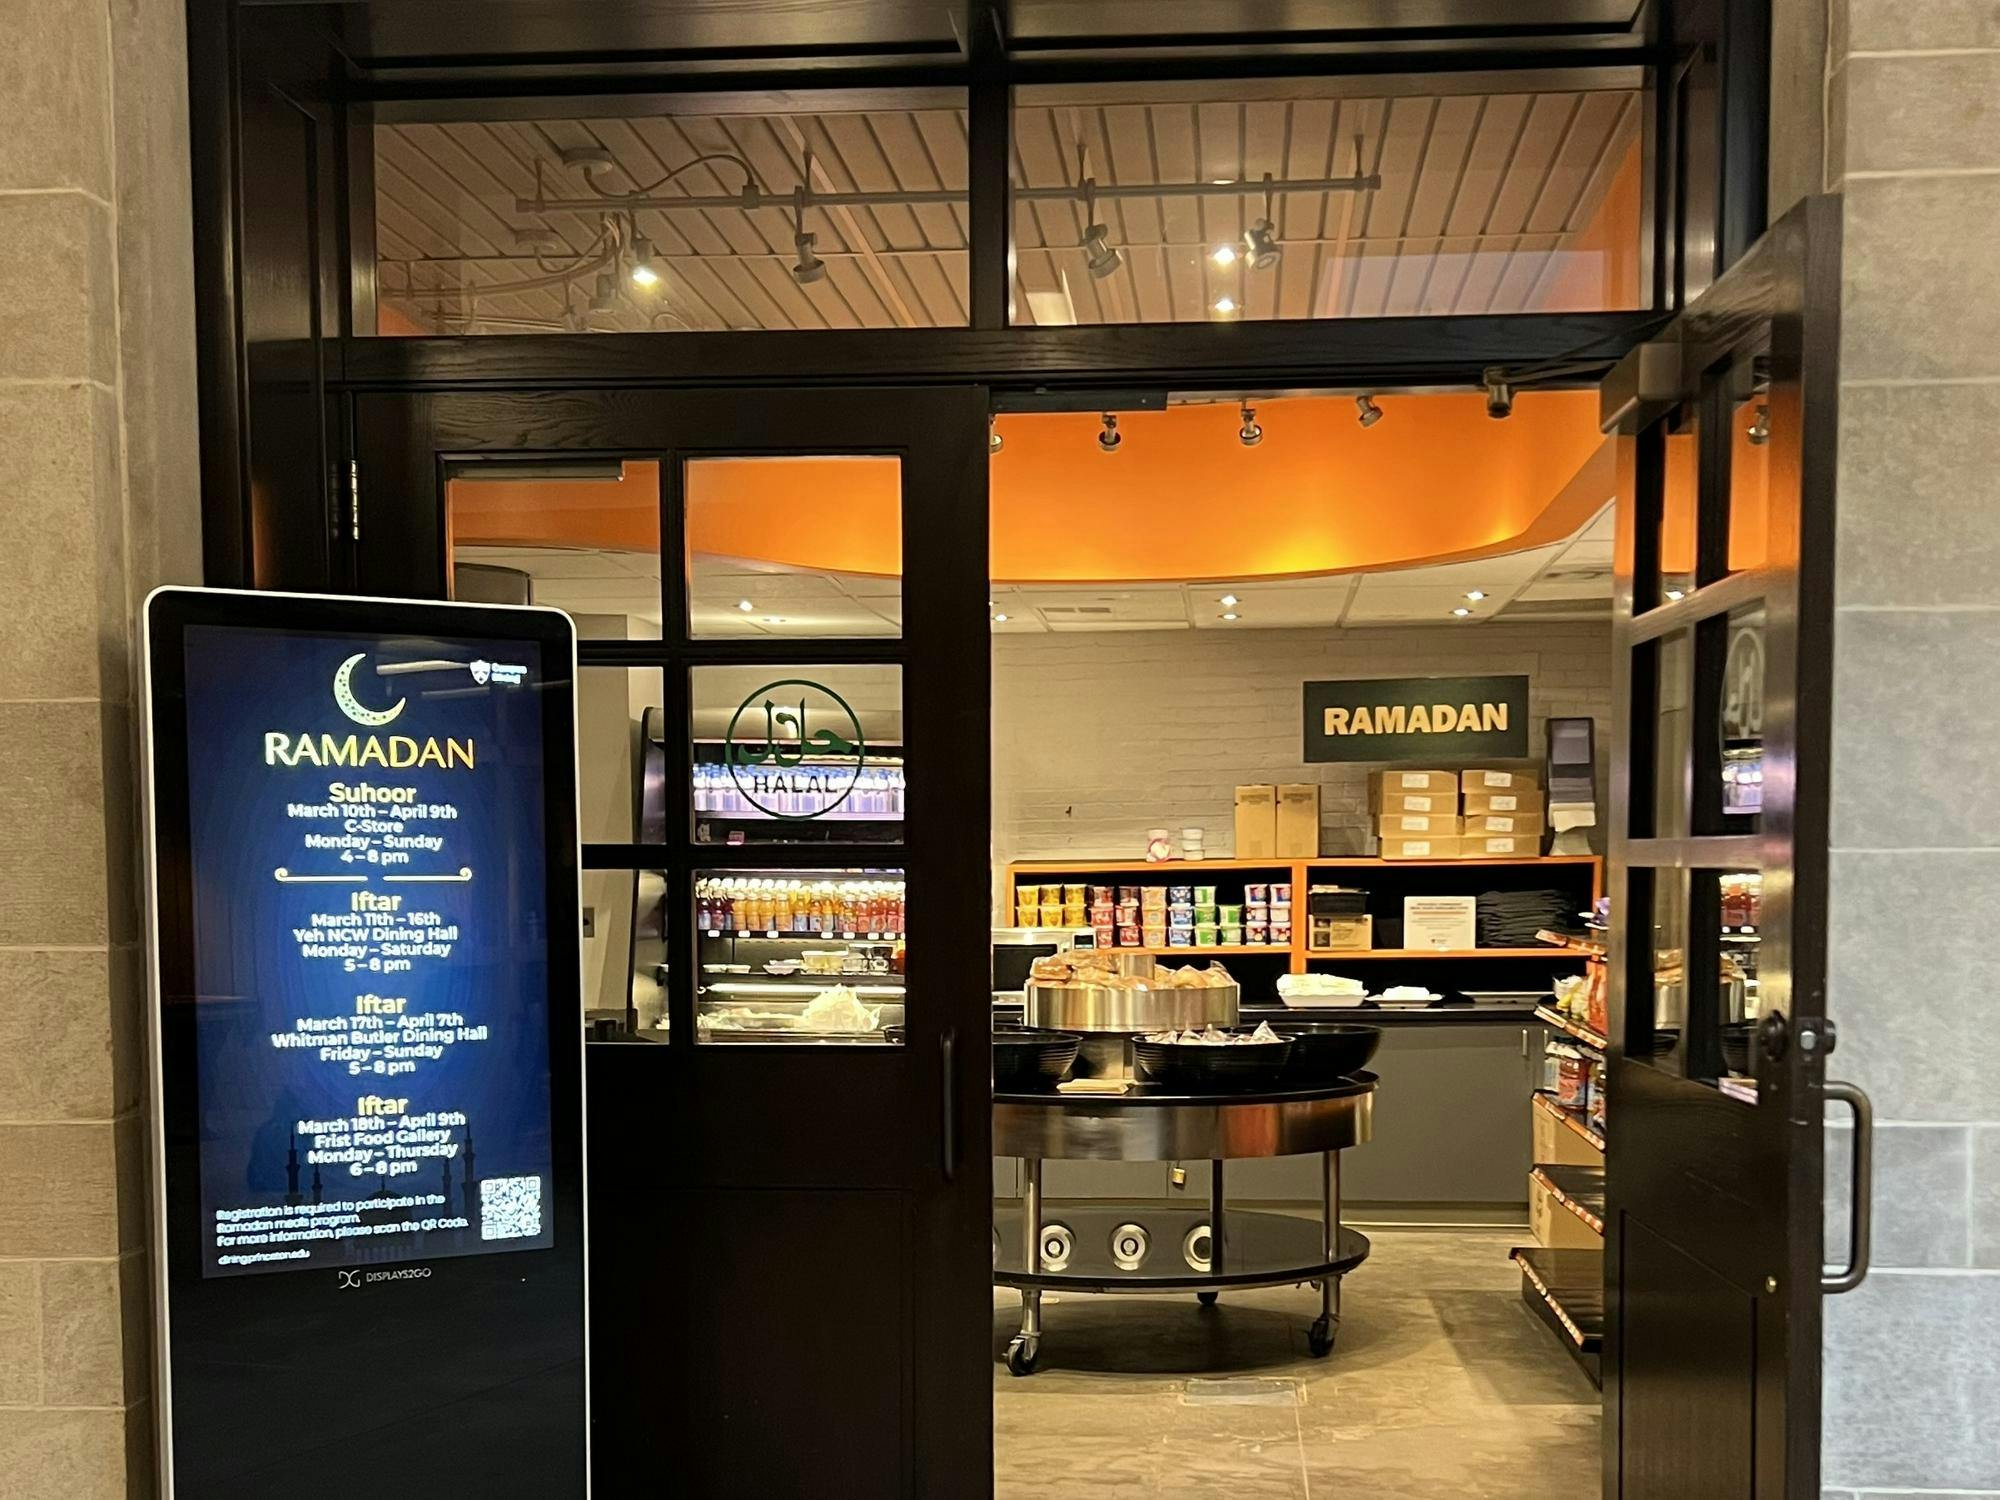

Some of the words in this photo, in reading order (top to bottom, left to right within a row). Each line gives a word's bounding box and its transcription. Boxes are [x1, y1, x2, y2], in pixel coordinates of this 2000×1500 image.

[1324, 702, 1509, 736] RAMADAN
[737, 697, 853, 768] حلال
[264, 732, 474, 769] RAMADAN
[329, 782, 417, 803] Suhoor
[753, 775, 838, 794] HALAL
[287, 803, 339, 818] March
[342, 804, 376, 818] 10th
[390, 804, 427, 821] April
[429, 804, 457, 819] 9th
[344, 819, 404, 833] C-Store
[304, 834, 371, 850] Monday
[383, 834, 443, 852] Sunday
[340, 850, 354, 863] 4
[367, 850, 379, 863] 8
[381, 852, 409, 866] pm
[351, 891, 402, 912] Iftar
[311, 913, 362, 927] March
[365, 913, 394, 926] 11th
[407, 912, 441, 925] 16th
[293, 929, 324, 943] Yeh
[328, 928, 369, 942] NCW
[373, 927, 424, 943] Dining
[428, 926, 458, 940] Hall
[302, 944, 367, 959] Monday
[381, 942, 451, 958] Saturday
[344, 958, 356, 972] 5
[369, 958, 381, 971] 8
[384, 959, 411, 974] pm
[356, 994, 406, 1014] Iftar
[297, 1016, 347, 1032] March
[350, 1015, 383, 1030] 17th
[397, 1013, 435, 1031] April
[437, 1013, 464, 1028] 7th
[271, 1031, 348, 1048] Whitman
[351, 1030, 400, 1045] Butler
[403, 1028, 454, 1045] Dining
[457, 1026, 488, 1041] Hall
[320, 1046, 371, 1062] Friday
[384, 1044, 443, 1060] Sunday
[349, 1061, 361, 1075] 5
[374, 1060, 386, 1074] 8
[388, 1060, 416, 1076] pm
[358, 1095, 408, 1116] Iftar
[298, 1118, 348, 1135] March
[398, 1113, 436, 1131] April
[437, 1112, 466, 1126] 9th
[314, 1134, 351, 1149] Frist
[354, 1131, 393, 1146] Food
[396, 1129, 451, 1144] Gallery
[308, 1148, 373, 1164] Monday
[385, 1143, 458, 1159] Thursday
[350, 1162, 363, 1176] 6
[390, 1160, 417, 1177] pm
[216, 1206, 282, 1222] Registration
[283, 1205, 293, 1216] is
[294, 1201, 341, 1216] required
[342, 1202, 355, 1212] to
[355, 1196, 414, 1213] participate
[415, 1195, 426, 1205] in
[426, 1194, 446, 1205] the
[216, 1220, 273, 1234] Ramadan
[216, 1235, 236, 1247] For
[237, 1234, 268, 1245] more
[335, 1226, 372, 1239] please
[373, 1223, 401, 1234] scan
[401, 1221, 420, 1232] the
[421, 1218, 437, 1231] QR
[366, 1267, 432, 1283] DISPLAYS2GO
